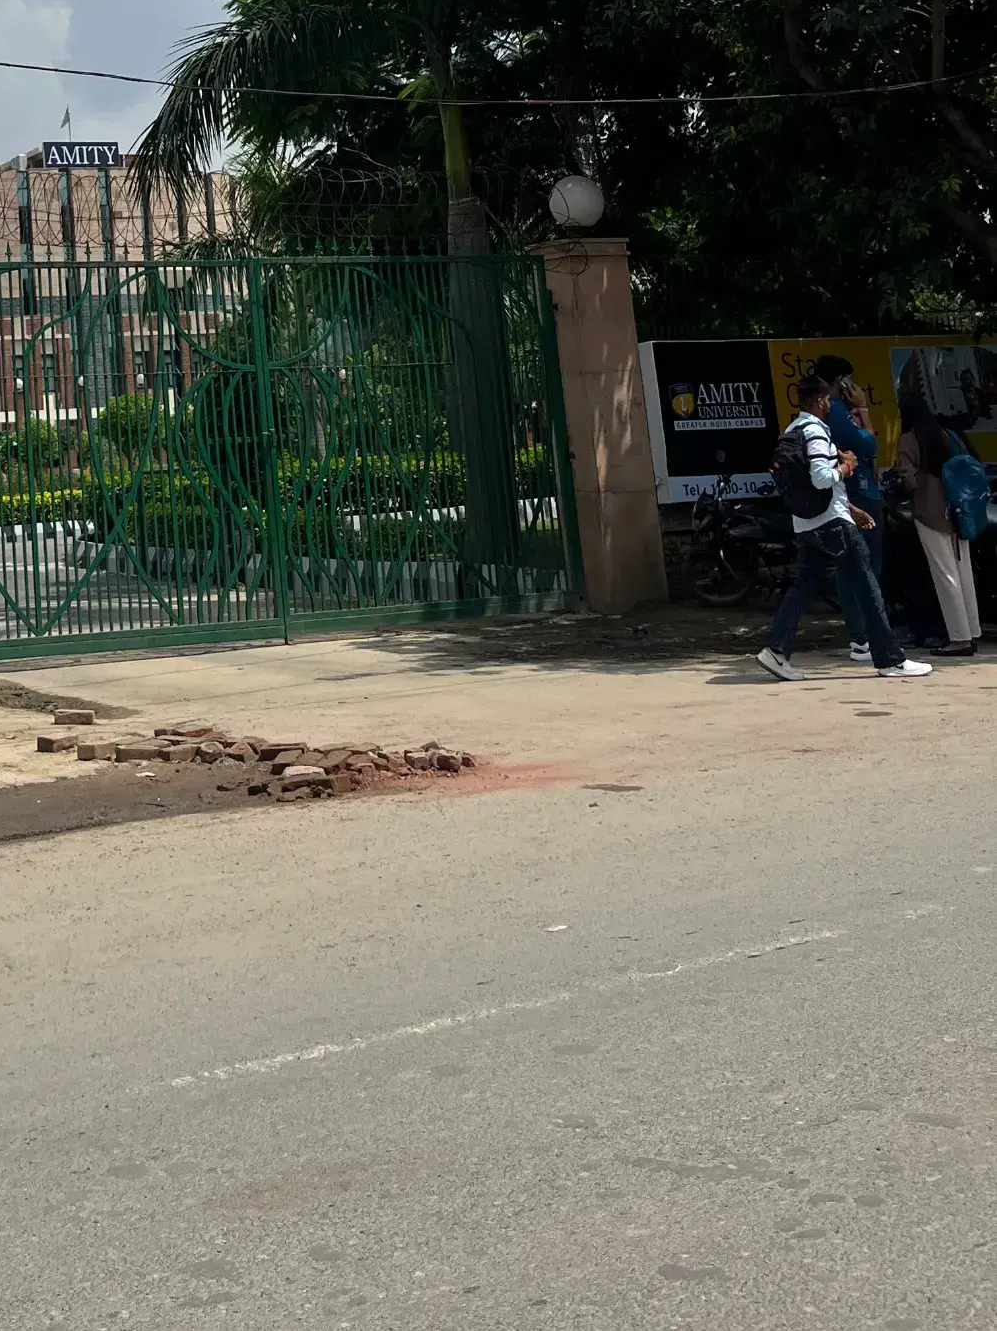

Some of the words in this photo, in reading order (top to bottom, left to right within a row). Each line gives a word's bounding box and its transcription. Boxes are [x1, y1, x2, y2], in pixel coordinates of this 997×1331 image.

[47, 145, 117, 165] AMITY
[696, 382, 761, 404] AMITY
[698, 405, 763, 418] UNIVERSITY
[676, 421, 707, 429] GREATER
[710, 420, 732, 428] NOIDA
[735, 419, 764, 427] CAMPUS
